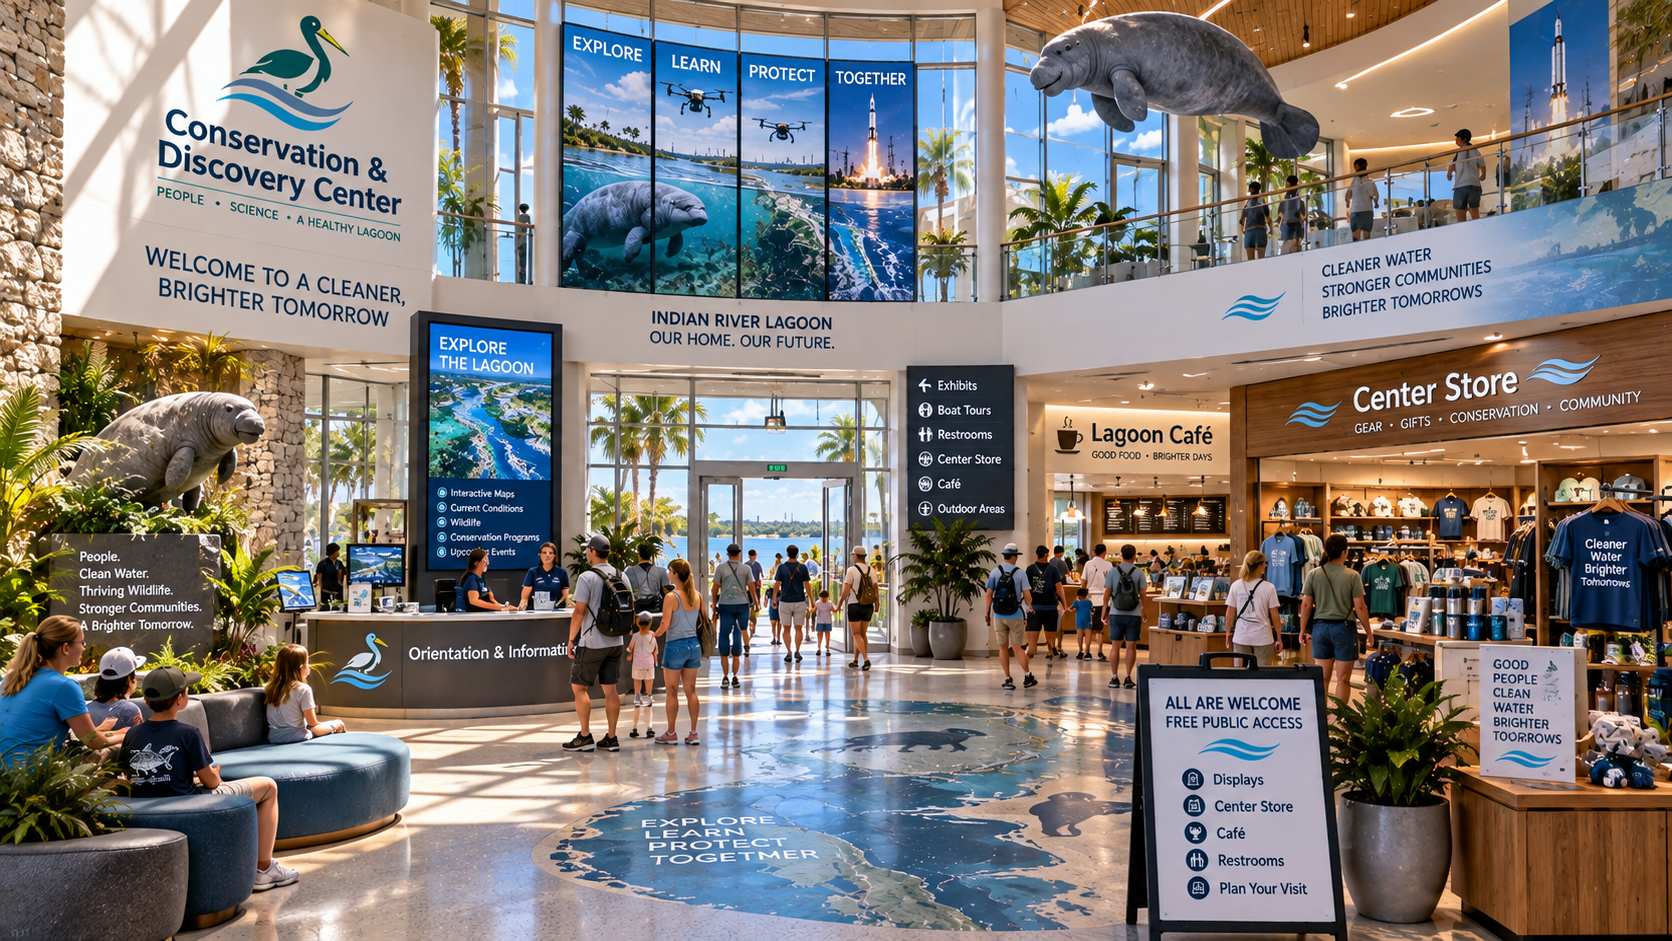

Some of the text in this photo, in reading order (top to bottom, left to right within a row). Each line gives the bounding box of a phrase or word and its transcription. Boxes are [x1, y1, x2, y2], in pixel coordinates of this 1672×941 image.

[572, 35, 643, 63] EXPLORE
[671, 54, 721, 74] LEARN
[749, 64, 816, 83] PROTECT
[835, 70, 906, 86] TOGETHER
[165, 108, 388, 183] Conservation &
[158, 139, 402, 216] Discovery Center
[156, 185, 401, 243] PEOPLE SCIENCE A HEALTHY LAGOON
[1321, 247, 1432, 278] CLEANER WATER
[145, 245, 406, 307] WELCOME TO A CLEANER,
[1321, 259, 1492, 298] STRONGER COMMUNITIES
[158, 277, 390, 327] BRIGHTER TOMORROW
[1322, 284, 1483, 319] BRIGHTER TOMORROWS
[651, 310, 832, 331] INDIAN RIVER LAGOON
[439, 336, 507, 355] EXPLORE
[649, 330, 835, 350] OUR HOME. OUR FUTURE.
[439, 355, 534, 375] THE LAGOON
[937, 380, 978, 391] Exhibits
[1353, 370, 1519, 413] Center Store
[937, 404, 992, 416] Boat Tours
[1354, 390, 1642, 434] GEAR GIFTS CONSERVATION COMMUNITY
[937, 429, 993, 440] Restrooms
[1091, 422, 1213, 448] Lagoon Café
[937, 453, 1002, 464] Center Store
[1091, 450, 1213, 461] GOOD FOOD BRIGHTER DAYS
[937, 478, 961, 489] Café
[450, 488, 515, 500] Interactive Maps
[450, 503, 524, 513] Current Conditions
[937, 503, 1005, 514] Outdoor Areas
[450, 532, 540, 543] Conservation Programs
[1585, 538, 1627, 549] Cleaner
[79, 551, 121, 564] People.
[491, 547, 516, 557] Events
[1590, 551, 1622, 561] Water
[79, 568, 149, 579] Clean Water.
[1585, 563, 1627, 577] Brighter
[79, 585, 125, 599] Thriving
[79, 601, 202, 616] Stronger Communities.
[80, 619, 194, 634] A Brighter Tomorrow.
[408, 645, 489, 661] Orientation
[493, 645, 504, 659] &
[1492, 658, 1529, 671] GOOD
[1493, 672, 1538, 685] PEOPLE
[1492, 687, 1531, 699] CLEAN
[1165, 696, 1301, 711] ALL ARE WELCOME
[1493, 701, 1534, 714] WATER
[1166, 715, 1303, 729] FREE PUBLIC ACCESS
[1493, 716, 1549, 730] BRIGHTER
[1213, 773, 1264, 788] Displays
[1214, 800, 1293, 812] Center Store
[641, 815, 776, 829] EXPLORE
[645, 827, 745, 840] LEARN
[1216, 826, 1246, 840] Café
[648, 837, 787, 852] PROTECT
[1218, 853, 1285, 867] Restrooms
[1219, 881, 1308, 895] Plan Your Visit
